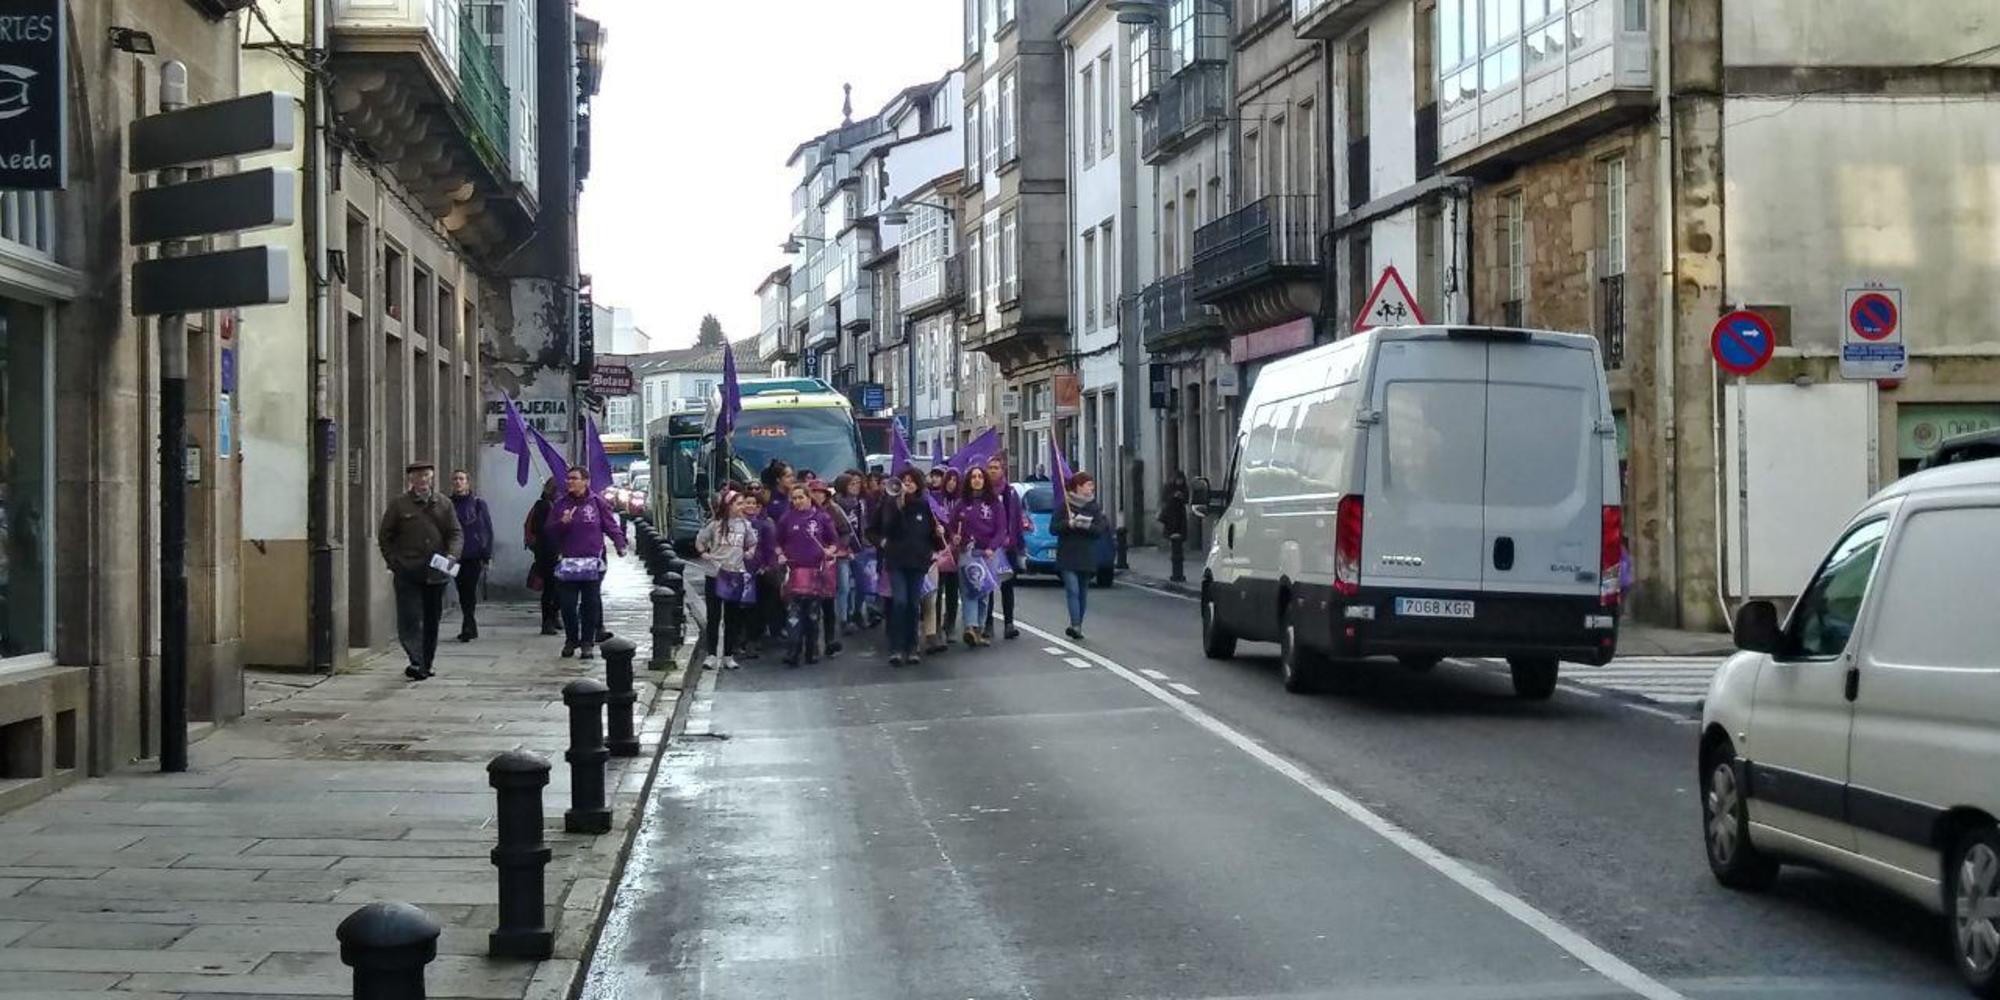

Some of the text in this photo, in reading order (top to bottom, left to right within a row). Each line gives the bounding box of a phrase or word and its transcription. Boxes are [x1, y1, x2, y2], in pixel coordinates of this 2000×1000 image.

[487, 401, 566, 414] REOJERIA
[1405, 600, 1472, 616] 7068 KGR
